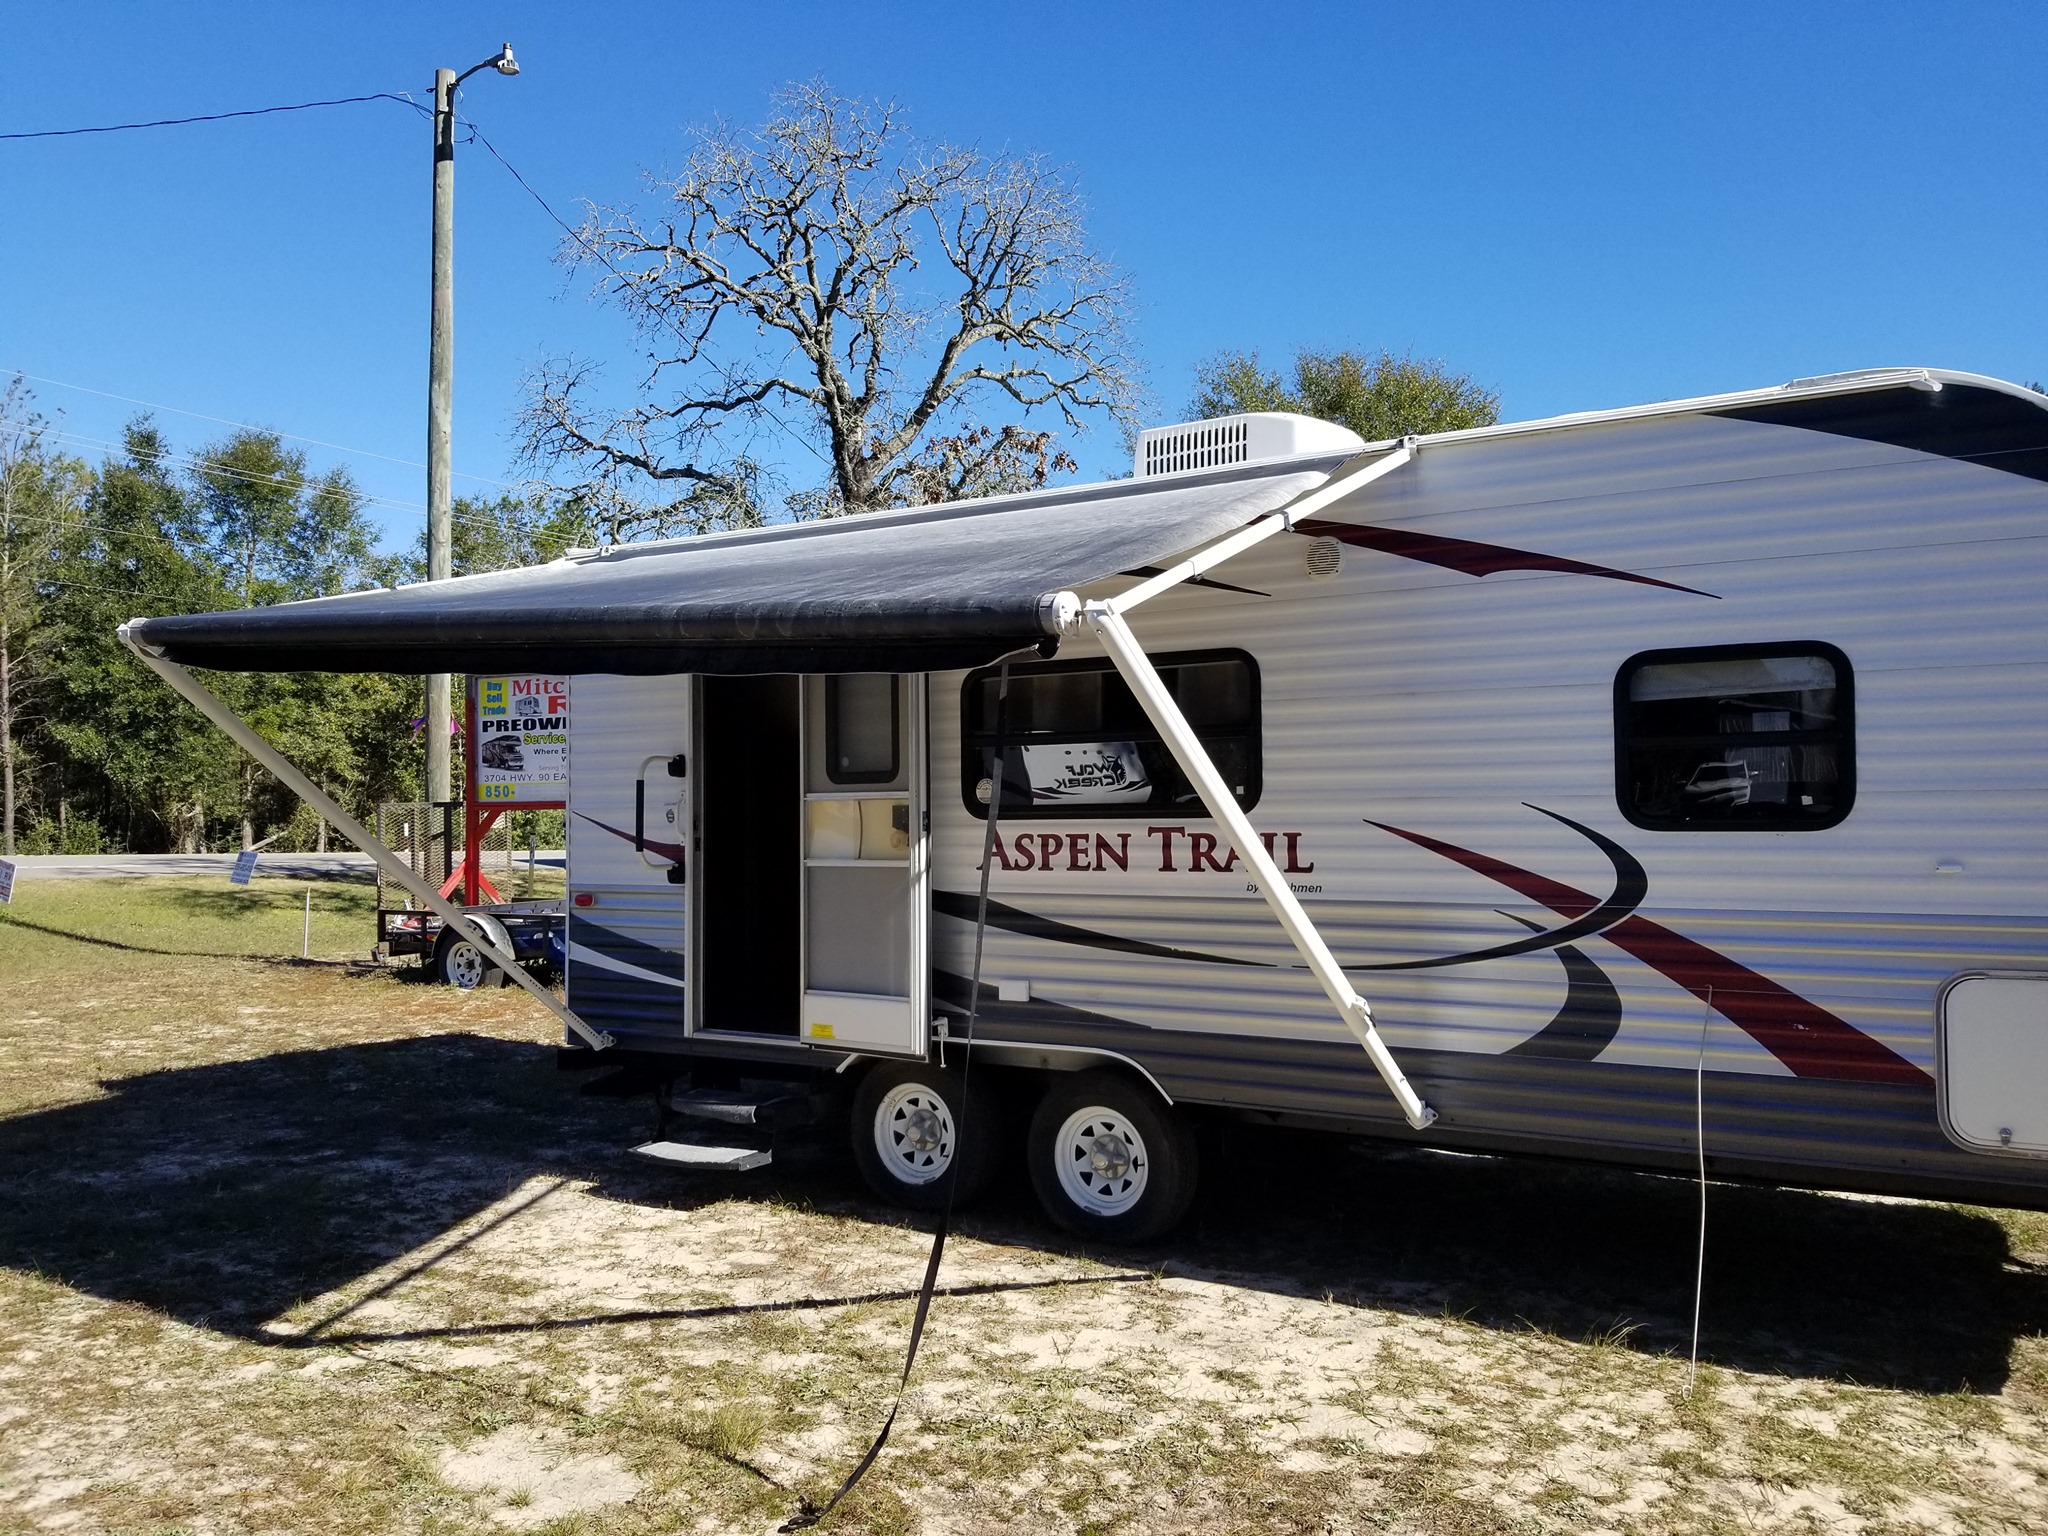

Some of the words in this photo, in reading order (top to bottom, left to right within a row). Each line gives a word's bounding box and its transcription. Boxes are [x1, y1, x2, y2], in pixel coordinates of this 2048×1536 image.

[486, 681, 503, 692] Buy
[486, 693, 503, 703] Sell
[482, 705, 507, 716] Trade
[482, 717, 567, 733] PREOW
[484, 774, 506, 783] 3704
[510, 774, 535, 782] HWY.
[538, 773, 550, 781] 90
[485, 784, 516, 798] 850-
[976, 827, 1132, 872] ASPEN
